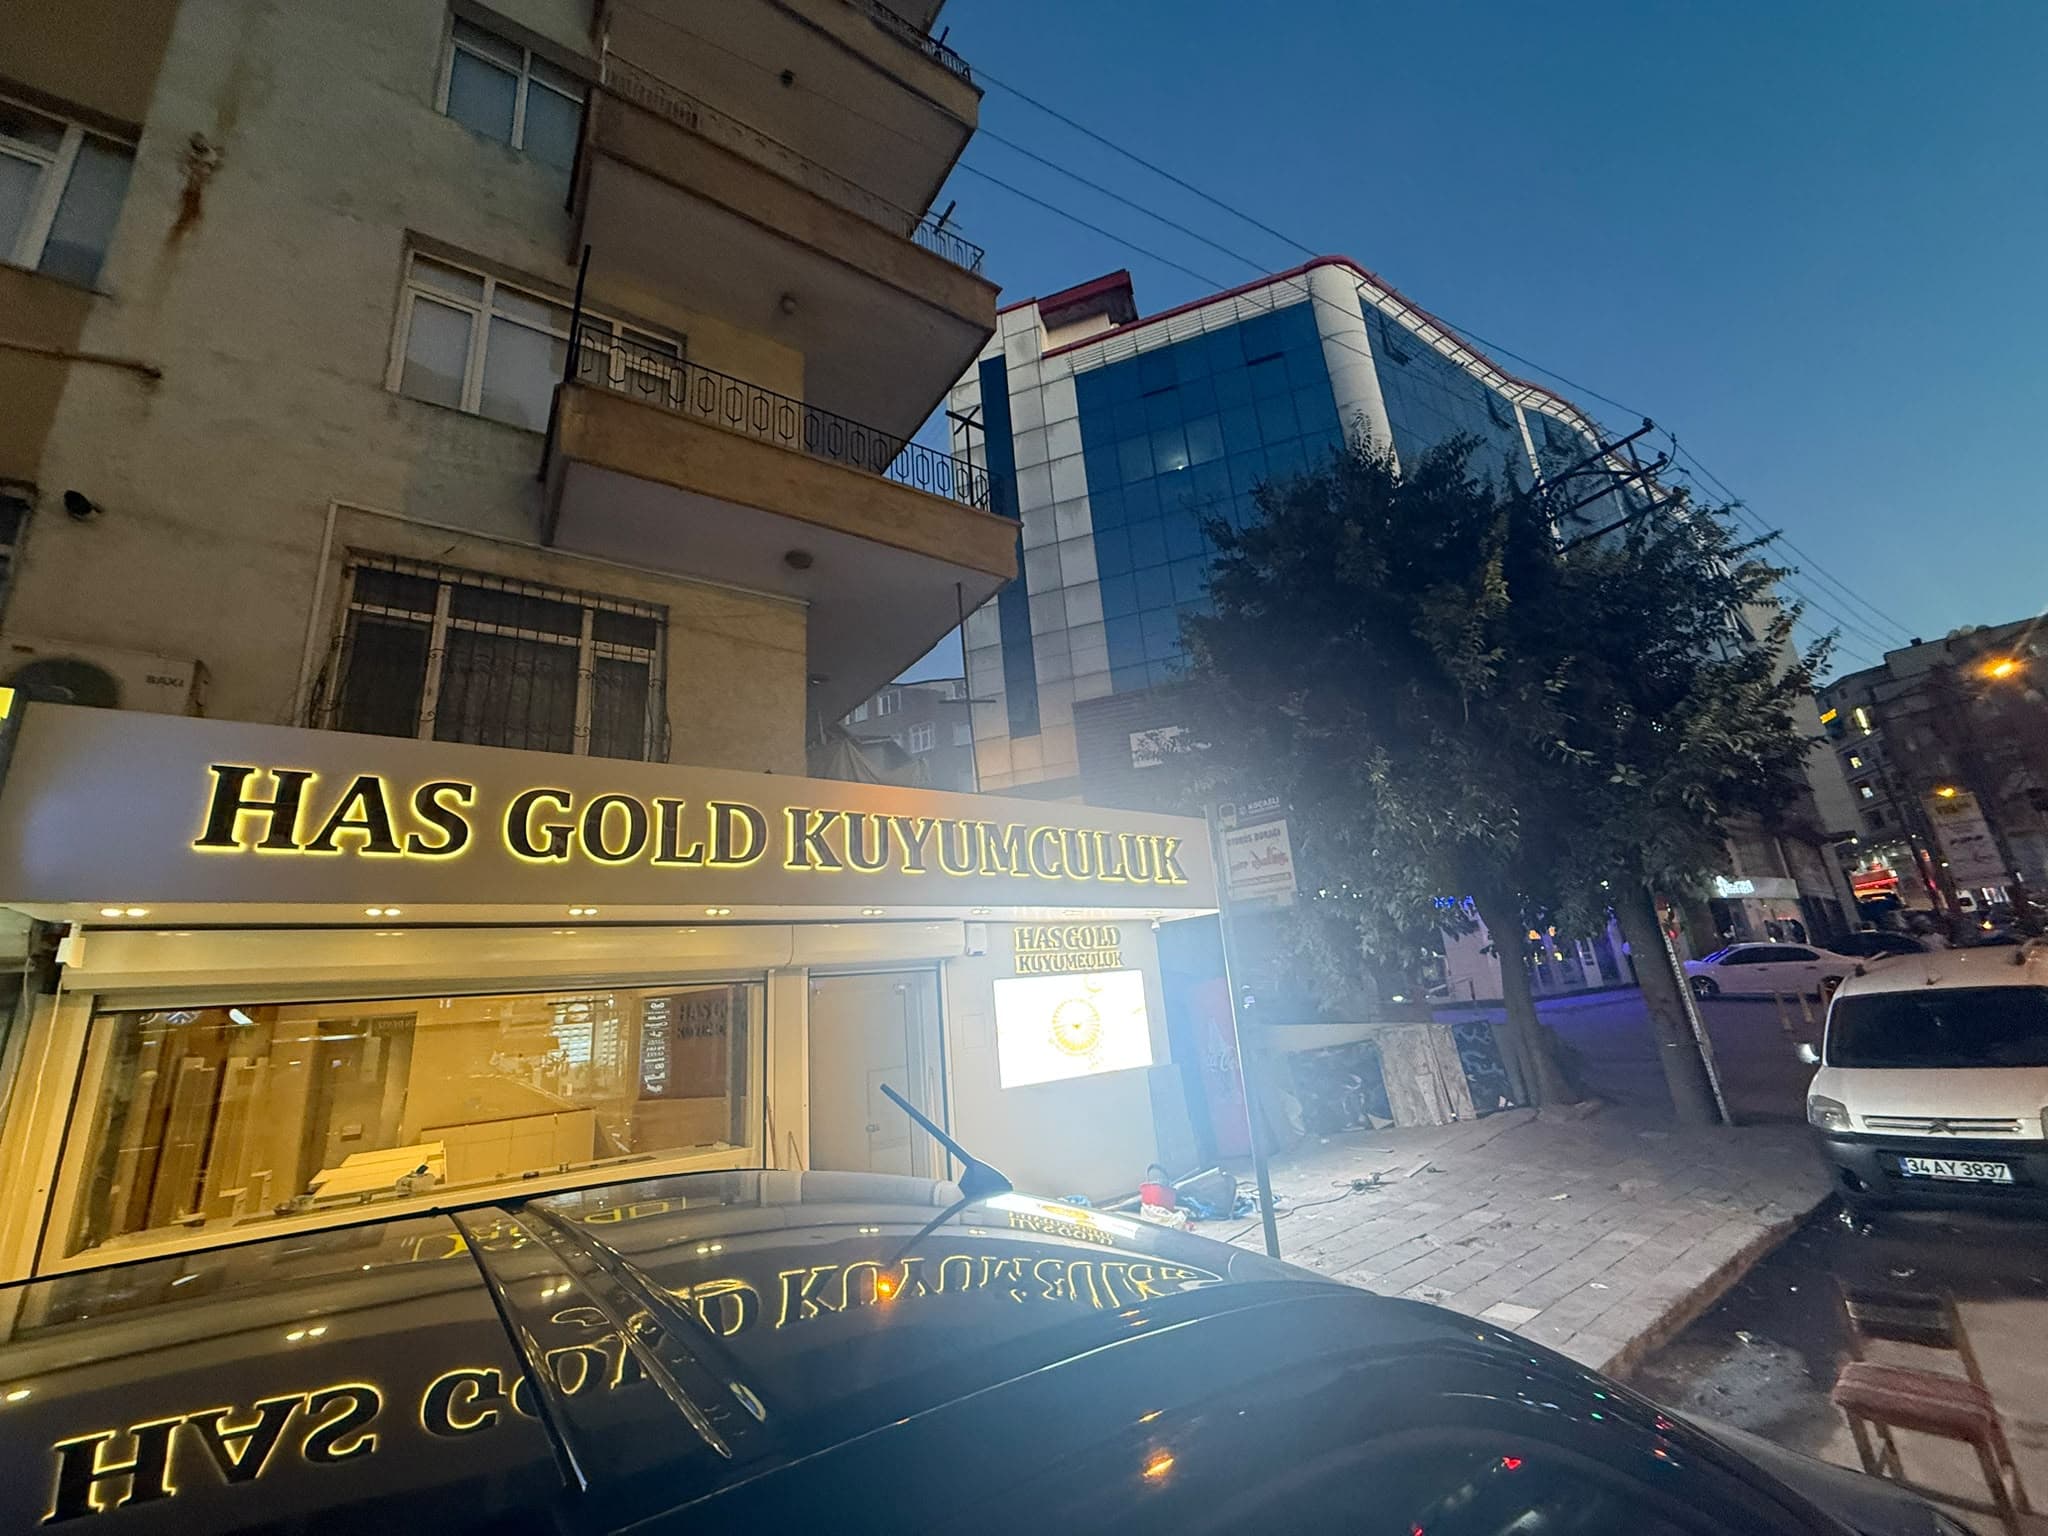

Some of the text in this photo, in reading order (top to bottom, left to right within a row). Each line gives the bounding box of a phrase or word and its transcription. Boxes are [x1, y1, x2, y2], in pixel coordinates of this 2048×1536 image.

[192, 764, 1188, 884] HAS GOLD KUYUMCULUK
[1908, 1159, 1930, 1173] 34
[1934, 1160, 1956, 1175] AY
